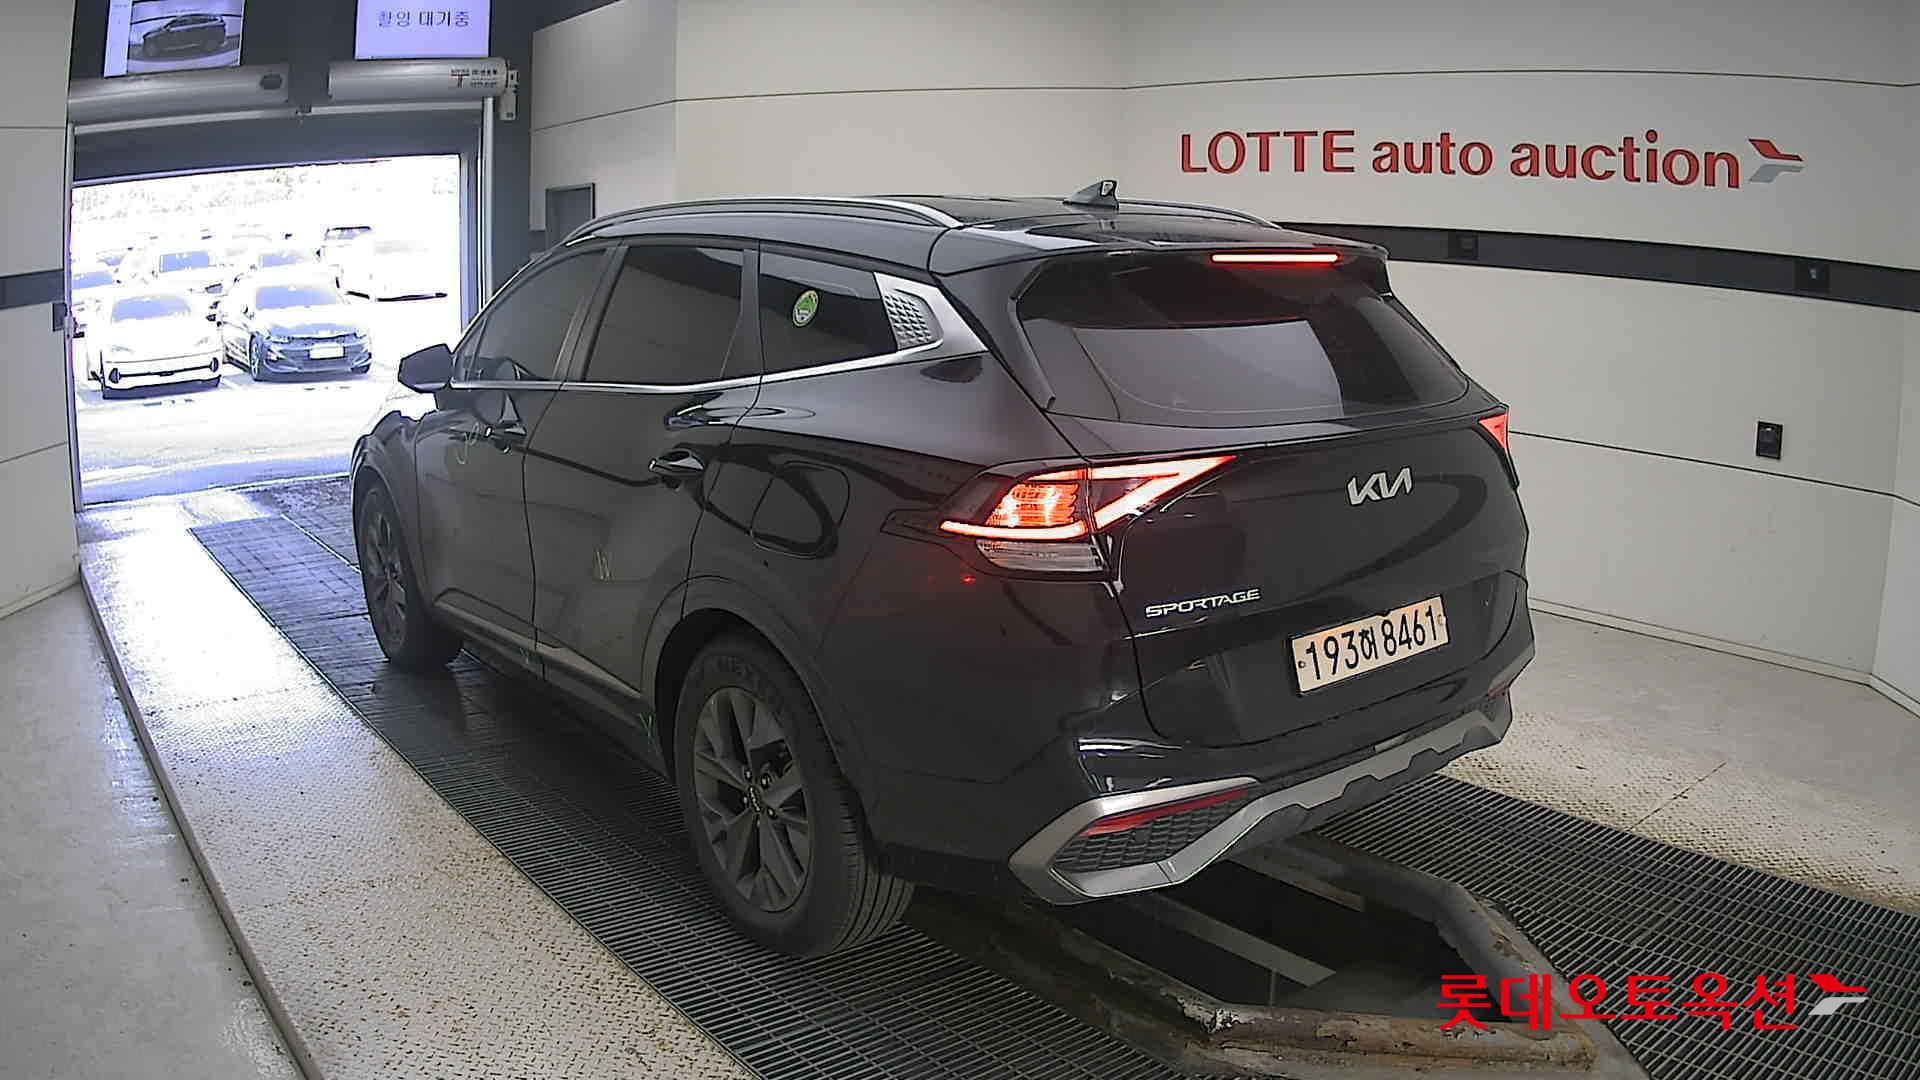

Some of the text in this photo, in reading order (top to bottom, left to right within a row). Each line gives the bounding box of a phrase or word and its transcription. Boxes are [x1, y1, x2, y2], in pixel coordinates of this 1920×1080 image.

[418, 9, 470, 28] 대기중
[1181, 129, 1741, 189] LOTTE auto auction
[1145, 588, 1261, 618] SPORTAGE
[1306, 604, 1438, 681] 193허 8461
